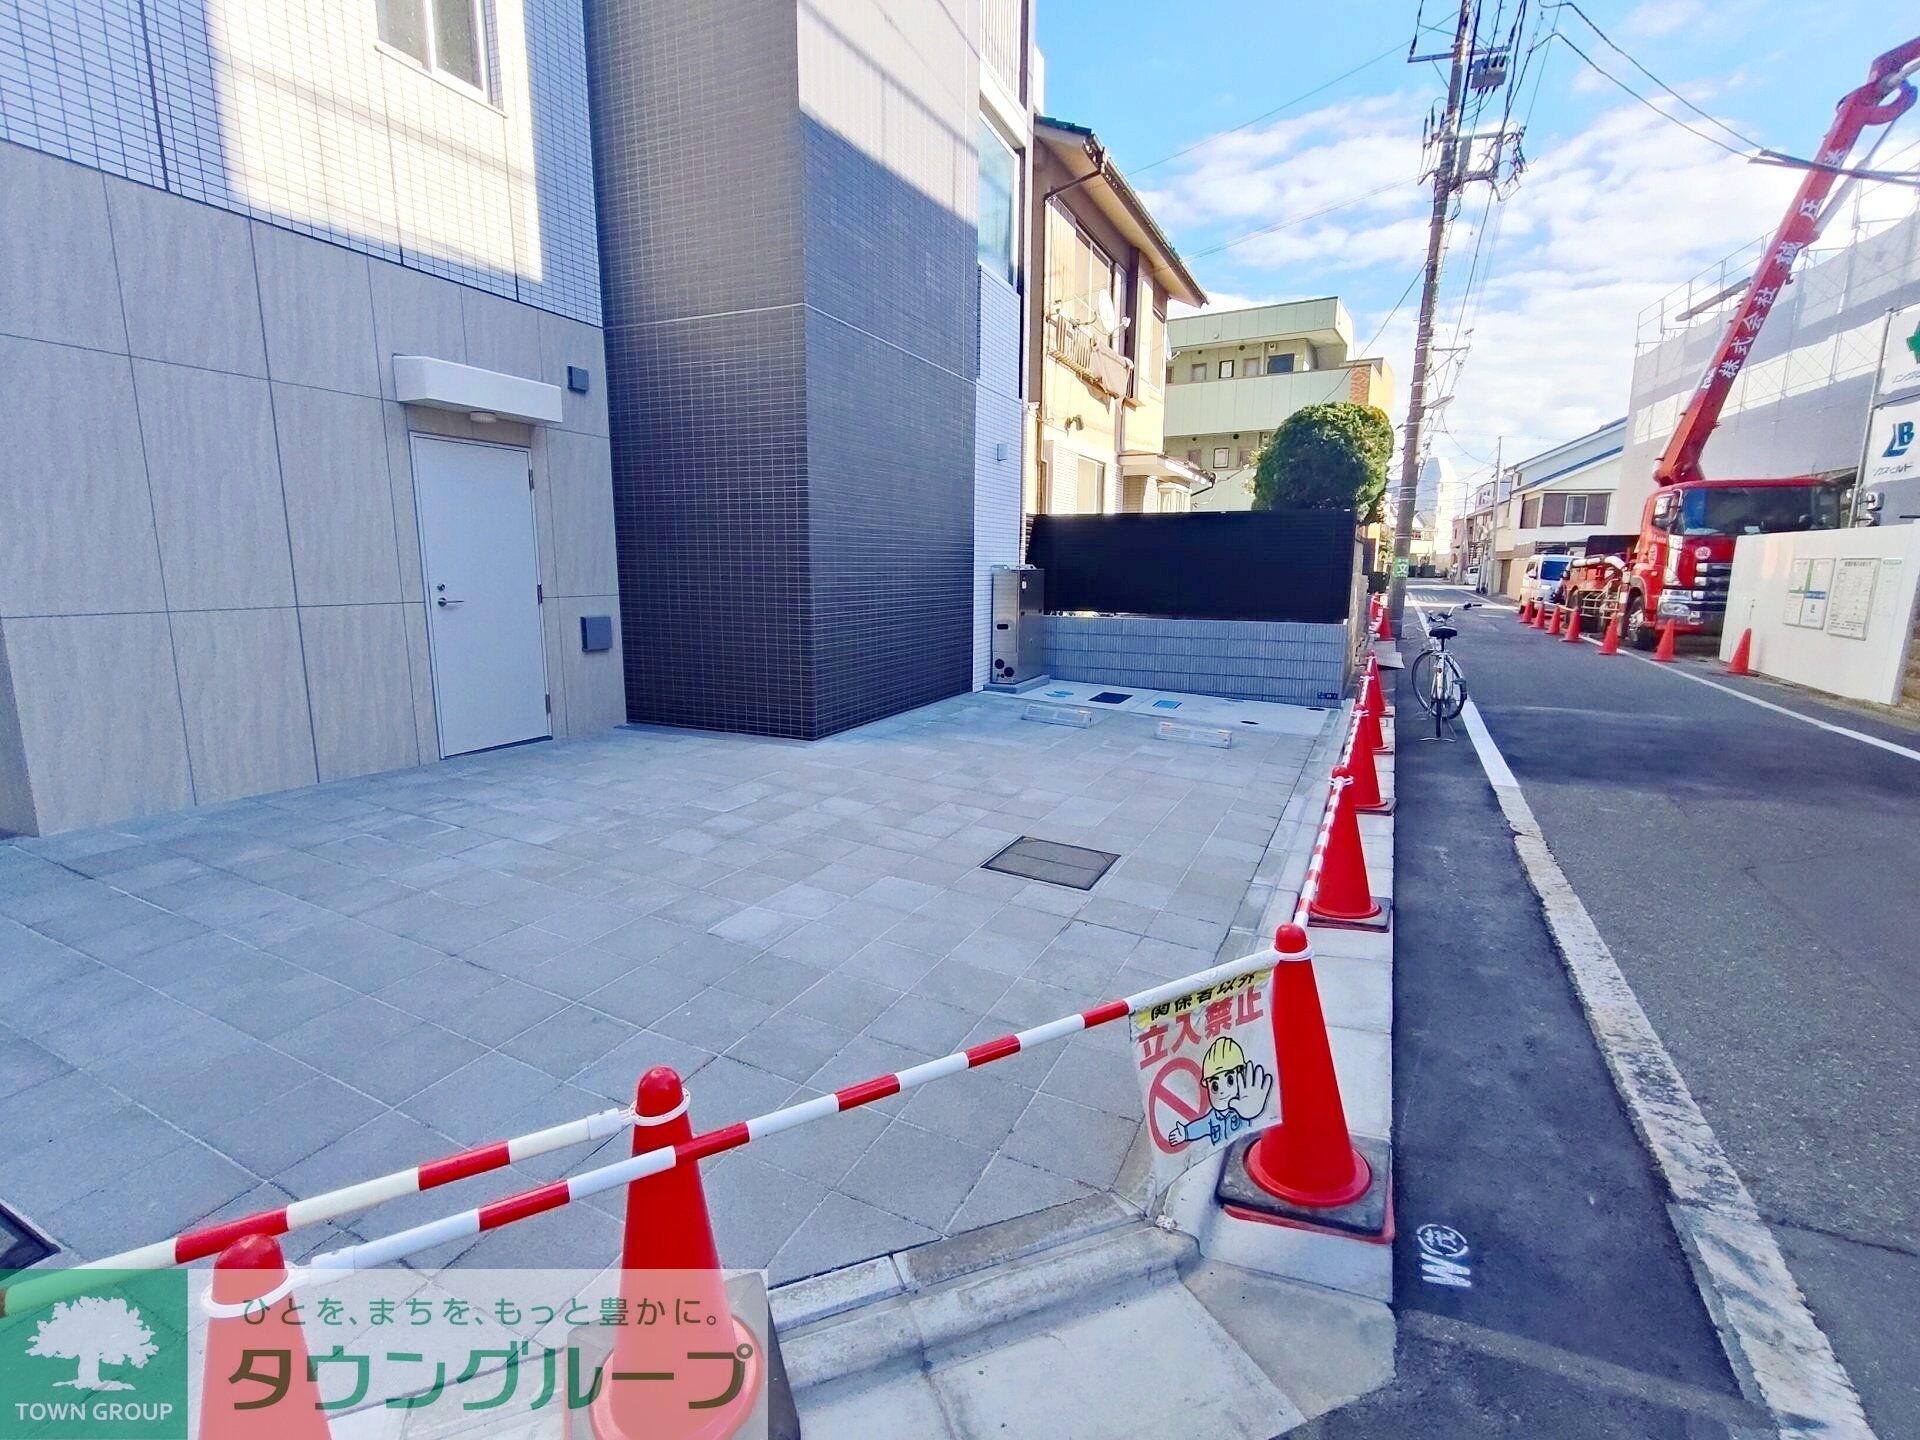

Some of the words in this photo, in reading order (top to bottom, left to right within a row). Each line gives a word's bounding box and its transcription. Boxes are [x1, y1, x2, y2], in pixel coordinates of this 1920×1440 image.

[1137, 985, 1265, 1071] 立入禁止
[1151, 973, 1256, 1021] 関係者以外
